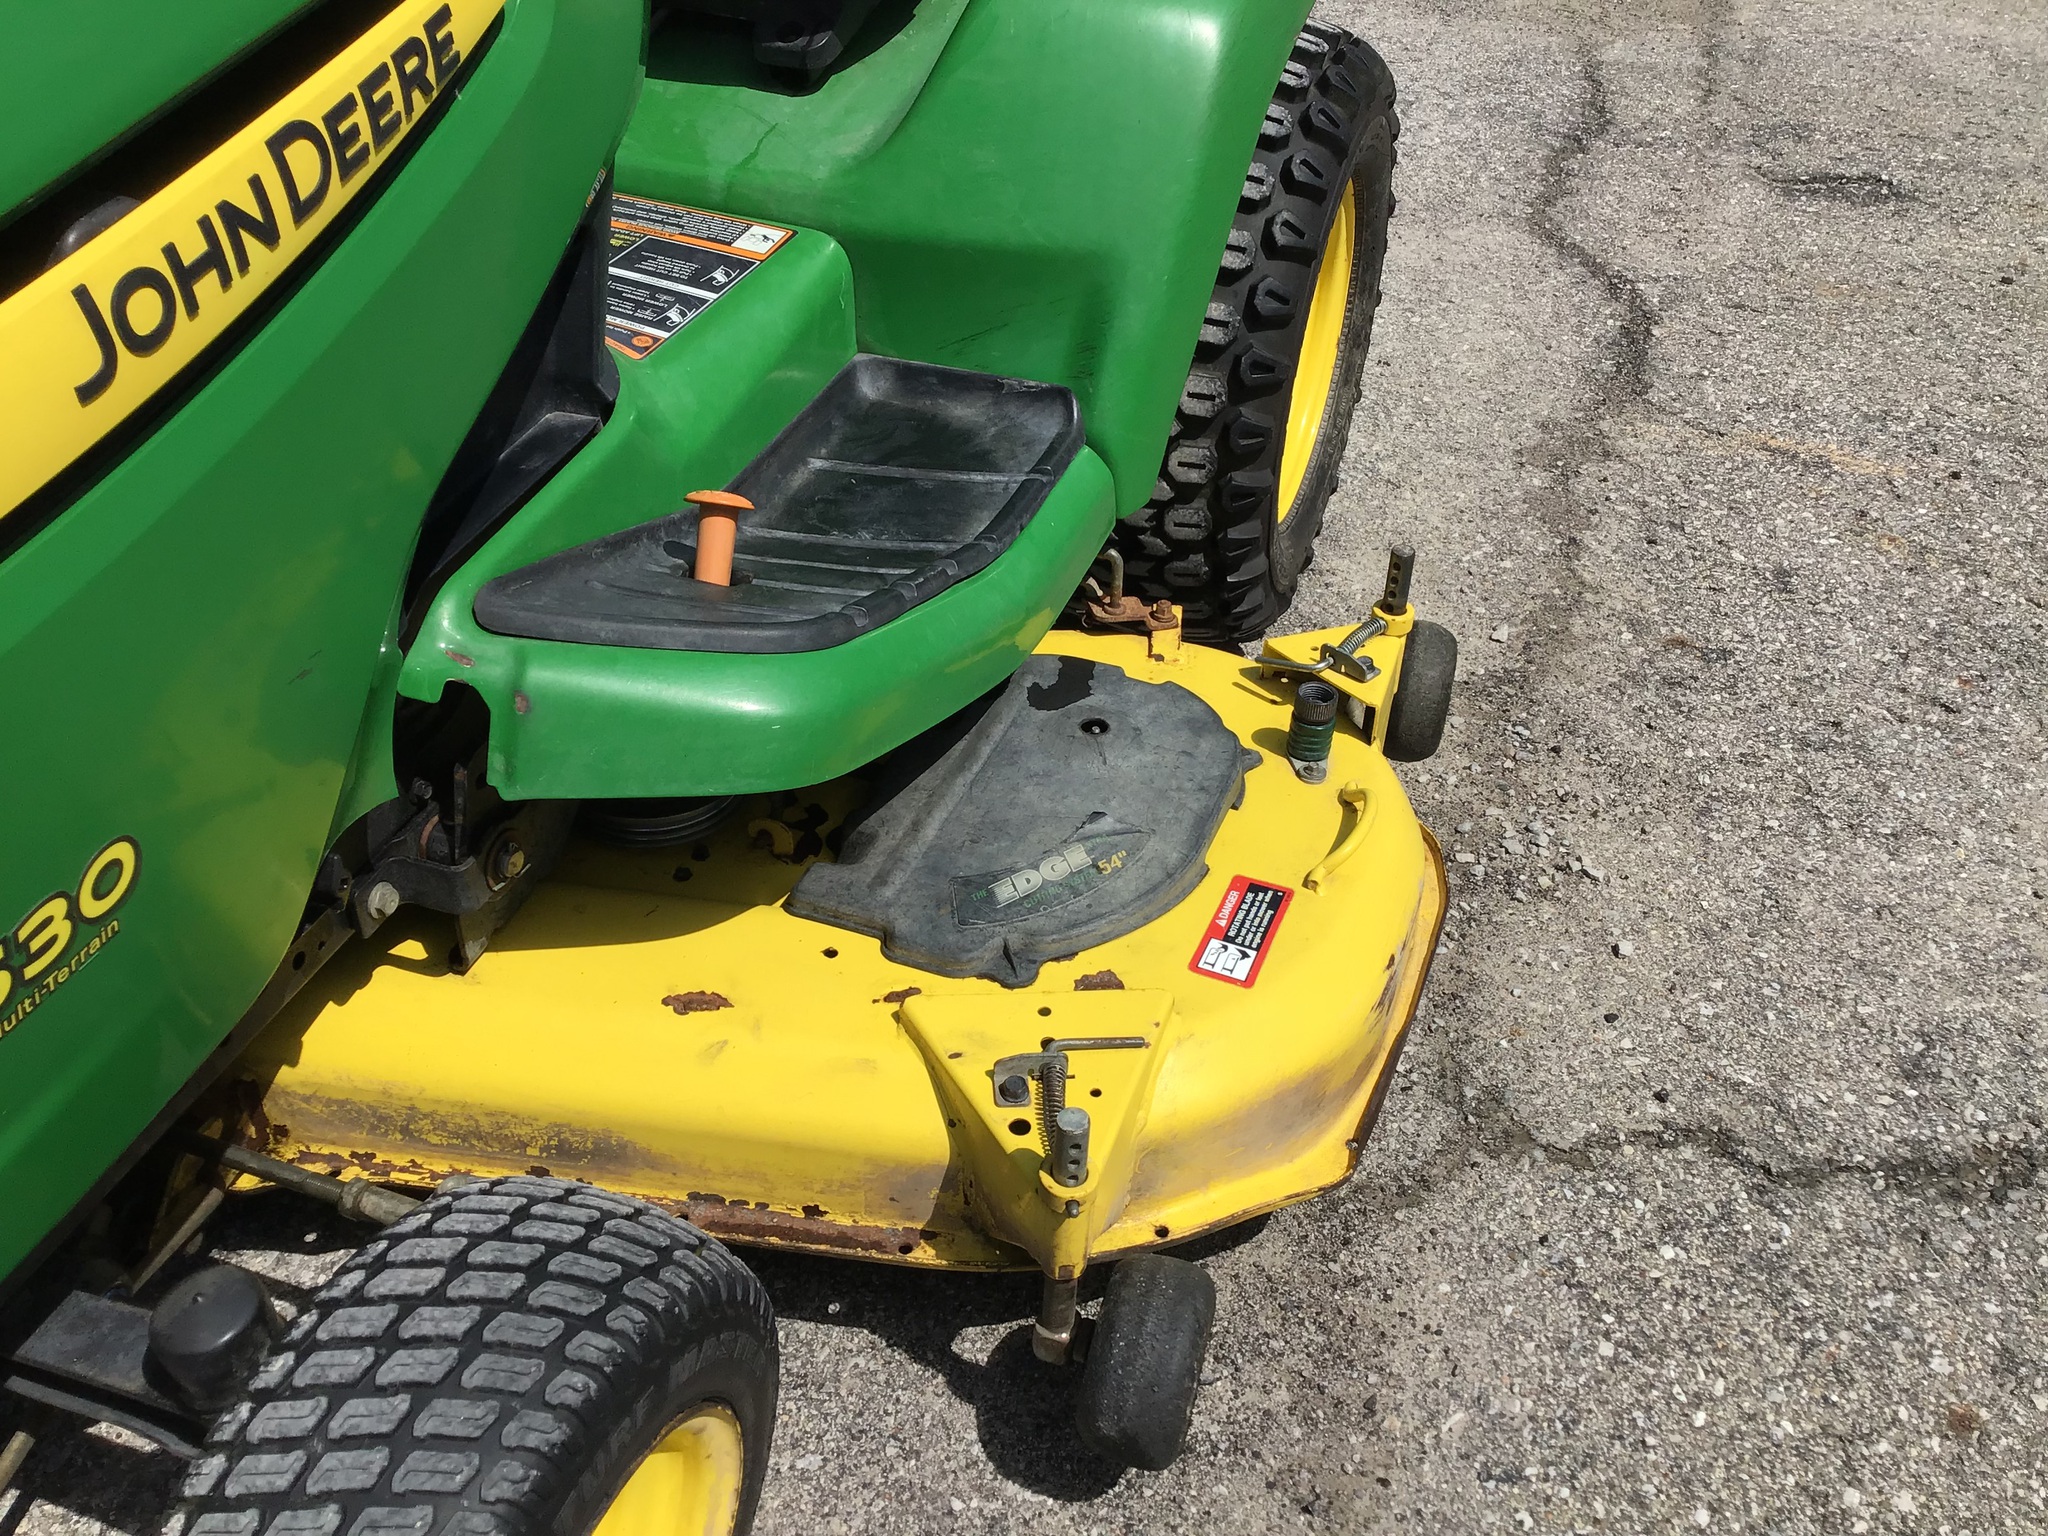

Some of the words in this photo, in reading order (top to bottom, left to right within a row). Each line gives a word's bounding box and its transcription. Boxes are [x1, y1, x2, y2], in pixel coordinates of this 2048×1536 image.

[70, 173, 281, 408] JOHN
[264, 2, 461, 231] DEERE
[626, 225, 667, 237] WARNING
[609, 306, 634, 314] MOWER
[621, 293, 646, 301] MOWER
[988, 844, 1093, 909] EDGE
[1097, 850, 1127, 875] 54"
[0, 839, 138, 1007] 30
[1219, 890, 1239, 919] DANGER
[1228, 909, 1246, 937] ROTATING
[1241, 892, 1254, 910] BLADE
[0, 920, 119, 1037] ulti-Terrain
